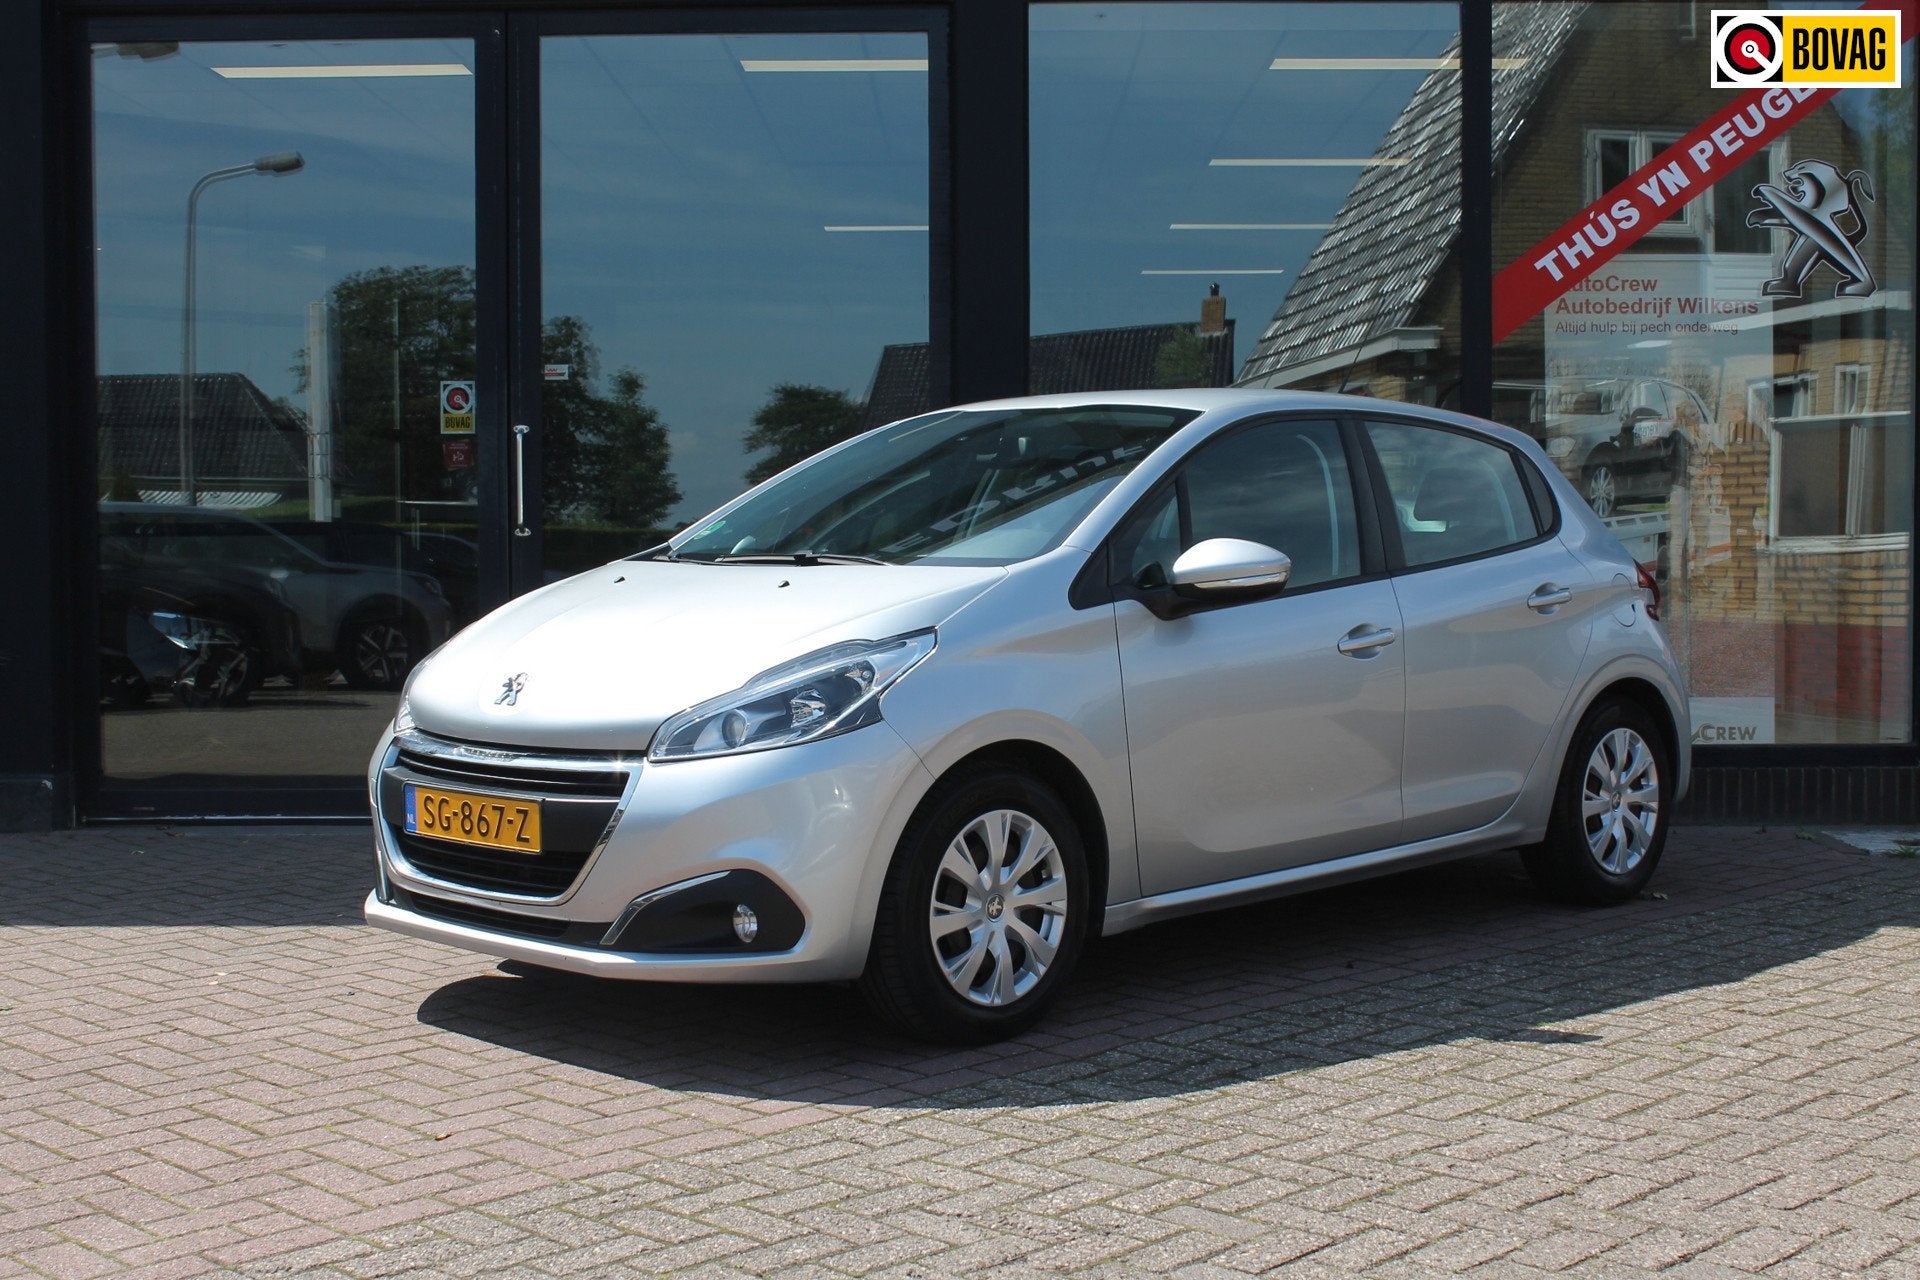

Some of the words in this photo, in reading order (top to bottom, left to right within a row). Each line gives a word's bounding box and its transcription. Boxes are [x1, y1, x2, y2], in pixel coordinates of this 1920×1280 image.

[1533, 199, 1640, 282] THÚS
[1637, 160, 1691, 207] YN
[1569, 275, 1657, 292] utoCrew
[1555, 297, 1671, 317] Autobedrijf
[1678, 297, 1759, 314] Wilkens
[1555, 321, 1586, 335] Altijd
[1591, 321, 1617, 335] hulp
[1622, 321, 1636, 335] bij
[1641, 321, 1671, 335] pech
[1675, 321, 1738, 336] onderweg
[445, 416, 471, 429] BOVAG
[423, 793, 530, 844] SG-867-Z
